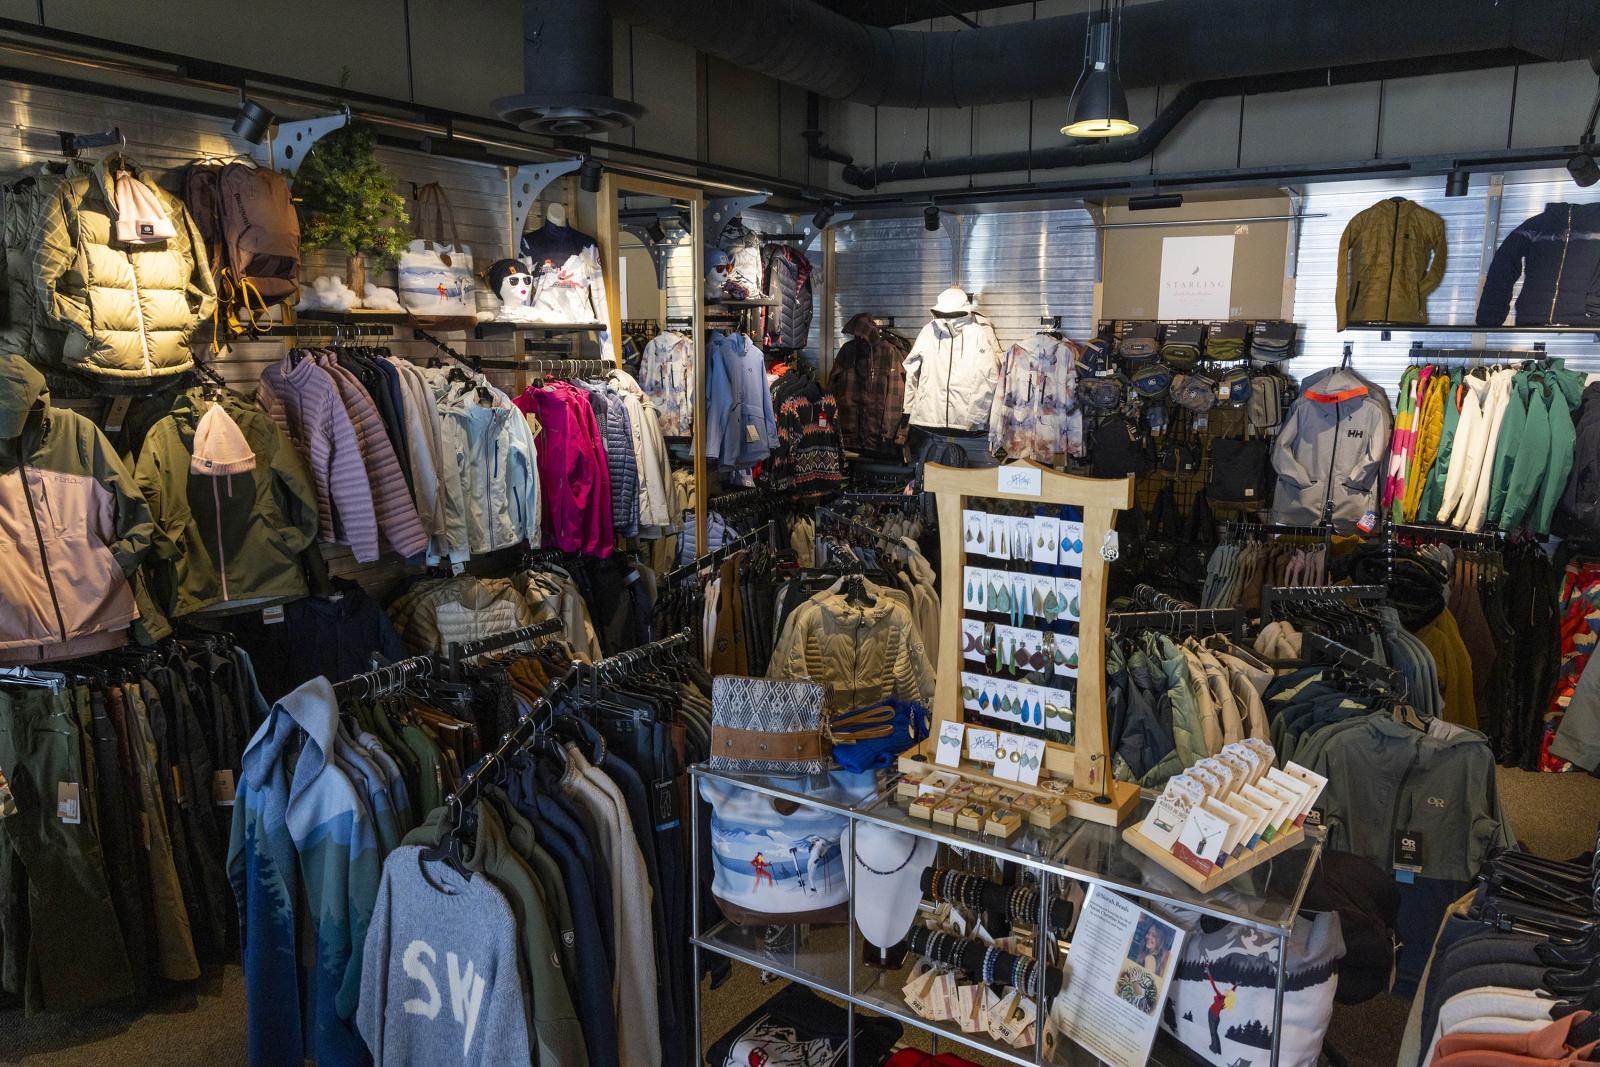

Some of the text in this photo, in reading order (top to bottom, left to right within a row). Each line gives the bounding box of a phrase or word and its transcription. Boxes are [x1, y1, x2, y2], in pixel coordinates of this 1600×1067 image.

[1166, 281, 1225, 289] STARLING
[1347, 430, 1363, 438] HH
[1427, 796, 1445, 808] OR
[1401, 838, 1416, 847] OR
[998, 1025, 1010, 1037] 988
